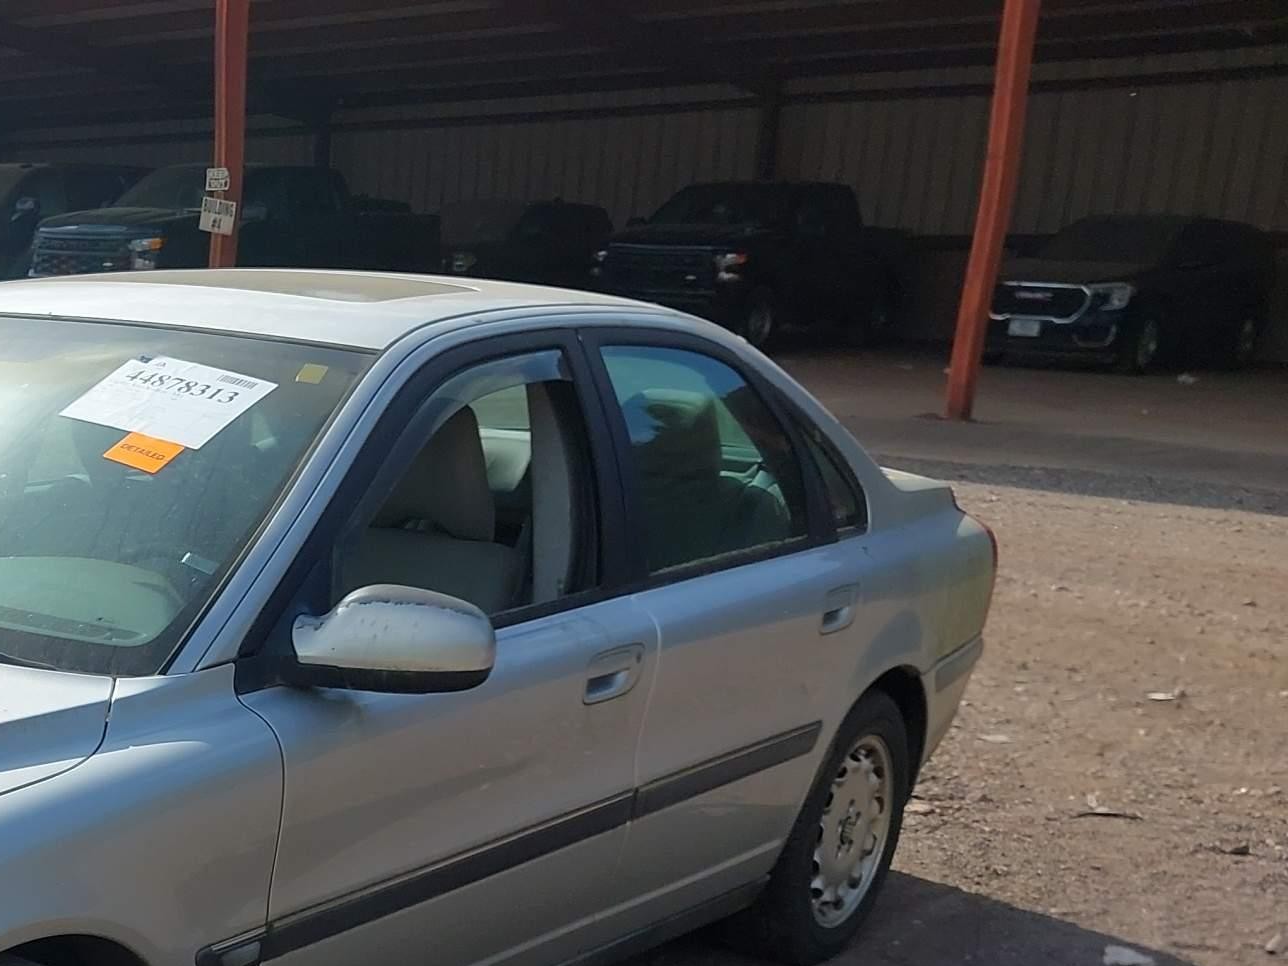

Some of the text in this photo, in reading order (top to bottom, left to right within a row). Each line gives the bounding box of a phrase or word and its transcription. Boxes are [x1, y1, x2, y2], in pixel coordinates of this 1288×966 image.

[203, 198, 234, 217] BUILDING
[125, 369, 241, 404] 44878313
[119, 443, 166, 461] DETAILED
